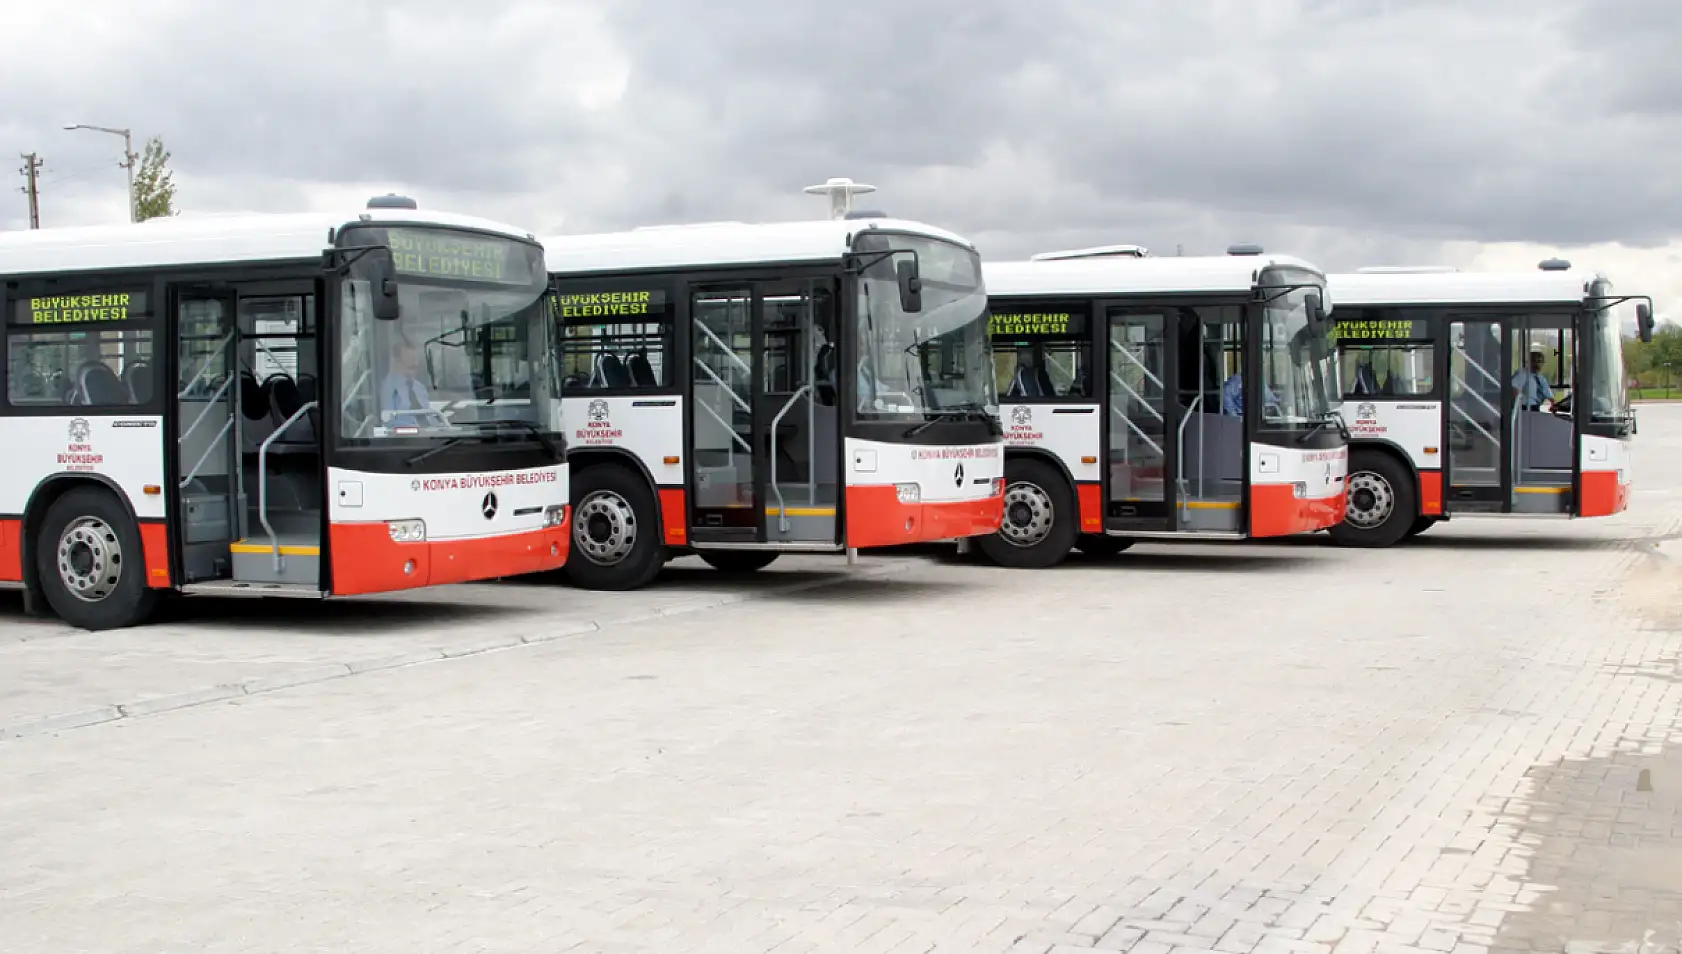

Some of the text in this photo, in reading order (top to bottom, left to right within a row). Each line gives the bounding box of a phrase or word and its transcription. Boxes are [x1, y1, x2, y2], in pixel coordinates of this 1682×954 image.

[551, 291, 650, 305] ÜYÜKŞEHIR
[562, 303, 648, 317] ELEDIYESI
[989, 323, 1067, 334] ELEDIYESI
[1335, 329, 1410, 339] ELEDIYESI
[423, 469, 557, 491] KONYA BÜYÜKŞEHİR BELEDİYESİ
